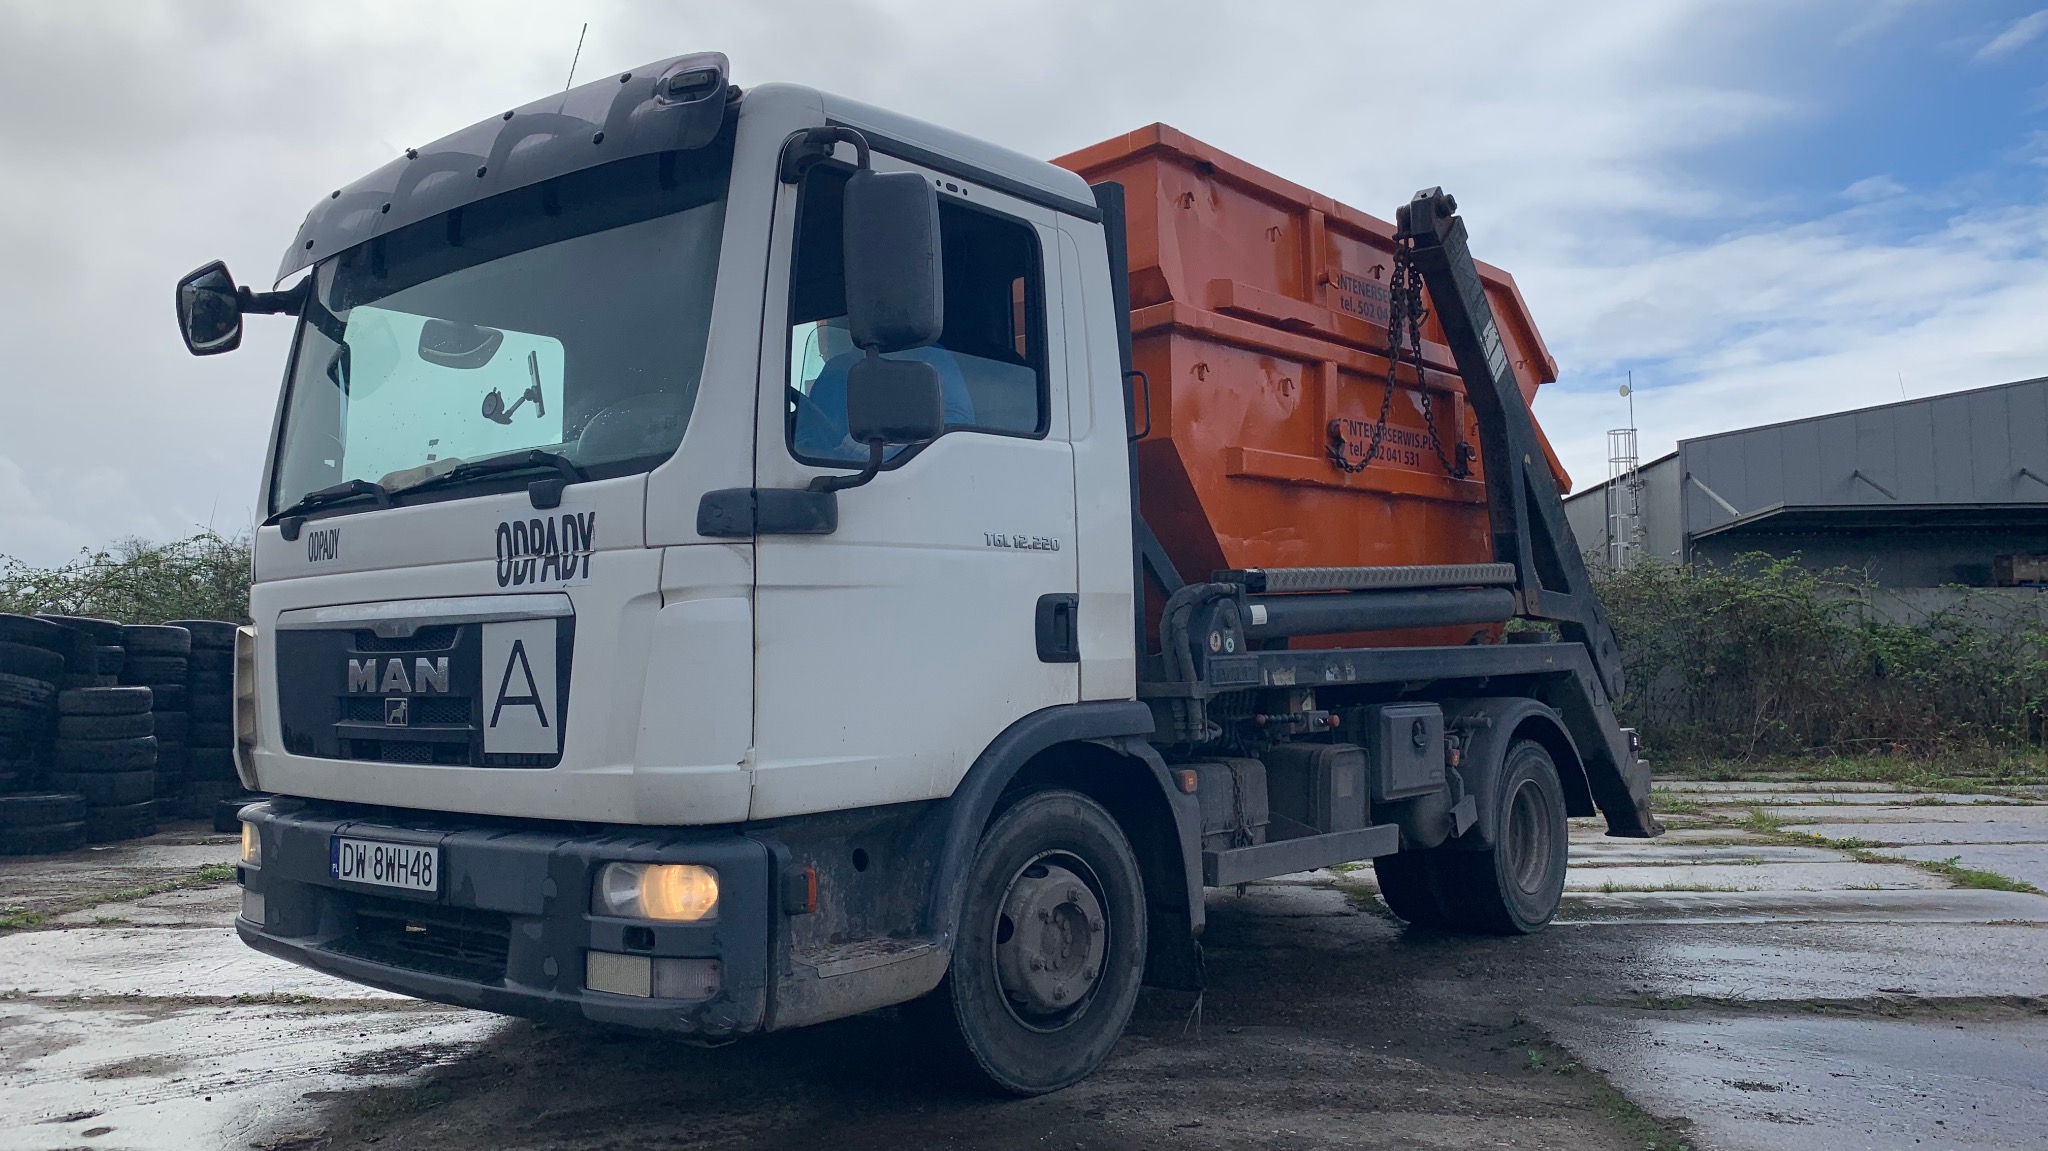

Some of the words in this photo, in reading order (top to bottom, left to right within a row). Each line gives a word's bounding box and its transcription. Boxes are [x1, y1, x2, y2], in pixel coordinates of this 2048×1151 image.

[1337, 274, 1391, 305] NTENERSE
[1340, 295, 1355, 313] tel.
[1358, 301, 1375, 318] 502
[1377, 307, 1388, 321] 04
[1342, 419, 1434, 451] NTENRSERWIS.PL
[1349, 441, 1366, 457] tel.
[1369, 444, 1384, 460] 02
[1386, 447, 1402, 464] 041
[1404, 451, 1420, 467] 531
[308, 528, 340, 562] ODPADY
[496, 511, 595, 588] ODPADY
[984, 532, 1011, 547] TGL
[1013, 535, 1060, 551] 12.220
[349, 657, 449, 692] MAN
[490, 639, 549, 728] A
[332, 863, 339, 873] PL
[343, 843, 367, 879] DW
[373, 846, 432, 887] 8WH48
